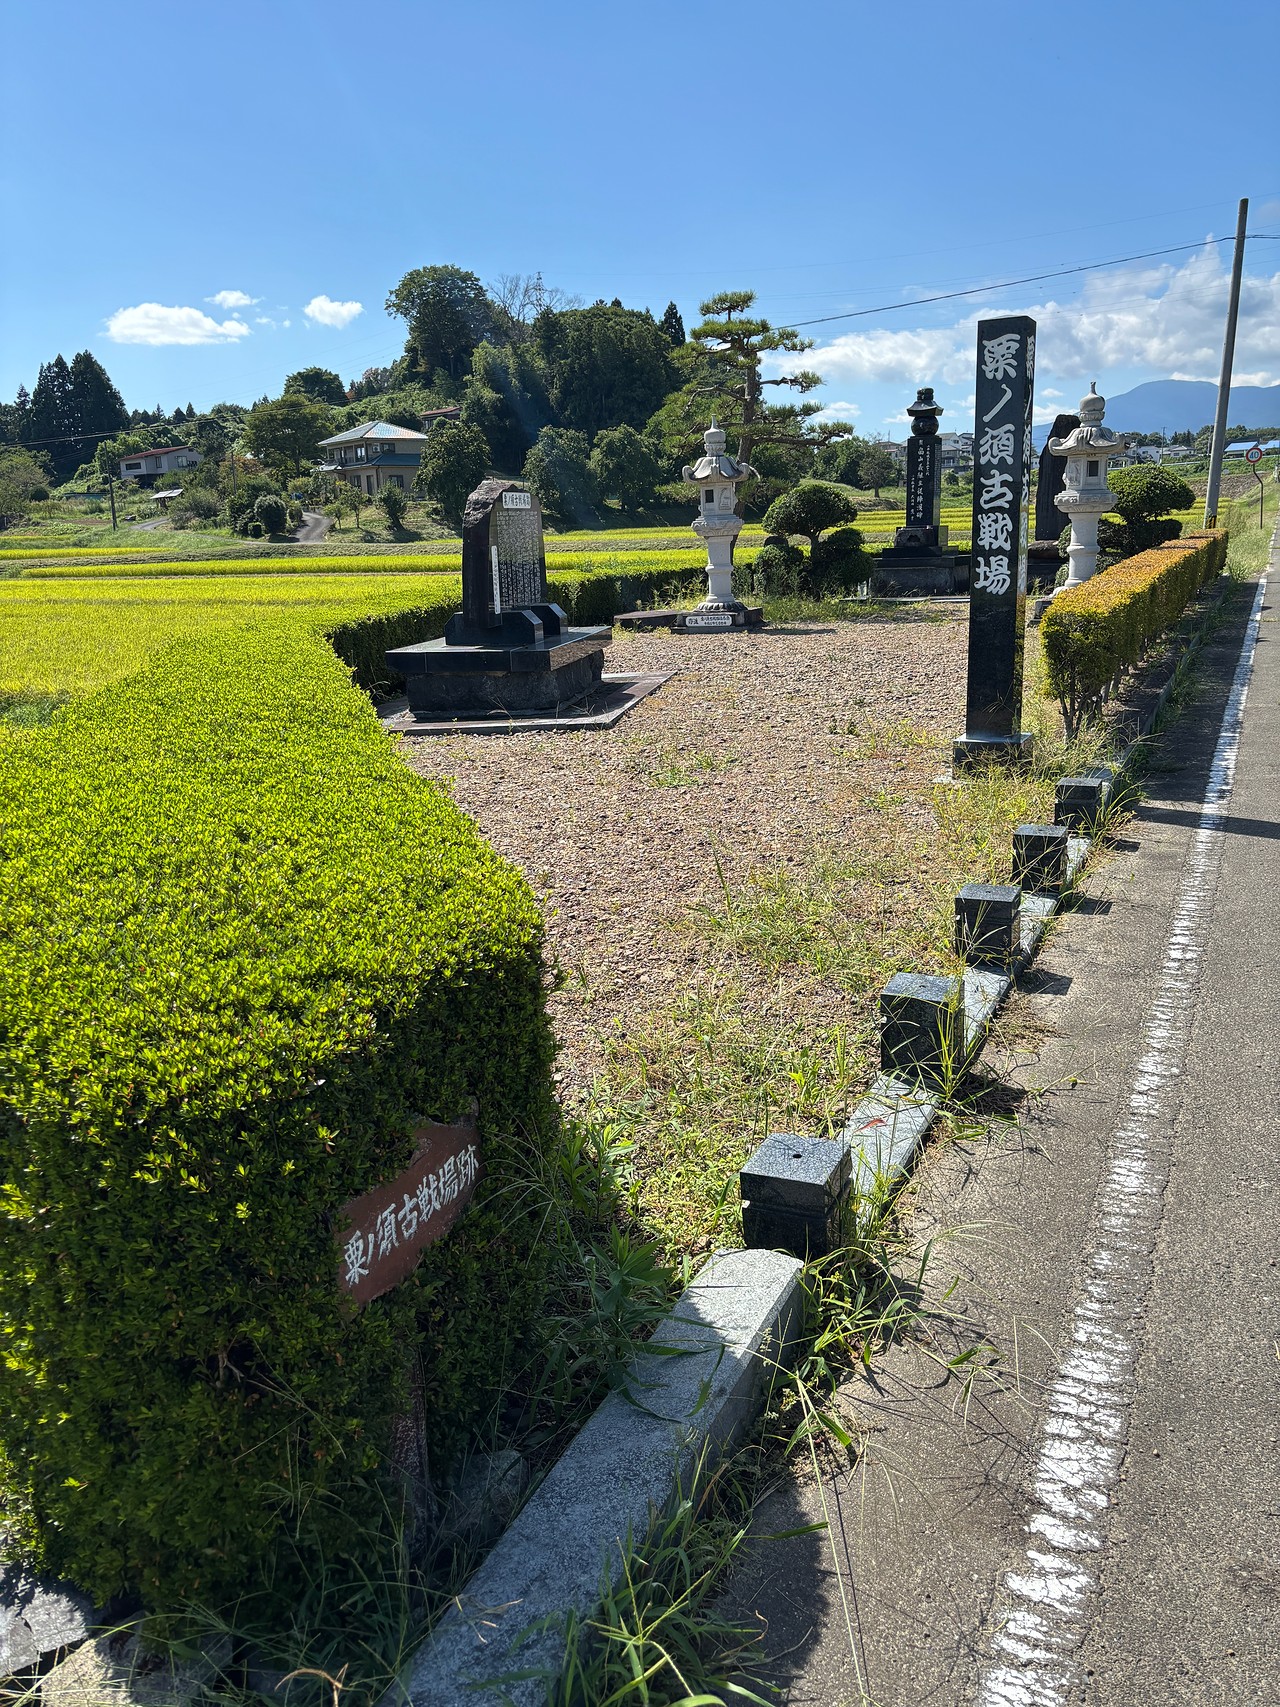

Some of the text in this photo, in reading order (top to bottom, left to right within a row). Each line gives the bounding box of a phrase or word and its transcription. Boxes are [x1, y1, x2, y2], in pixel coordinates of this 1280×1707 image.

[974, 333, 1021, 596] 粟ノ須古戦場
[1250, 451, 1260, 459] 40
[344, 1144, 479, 1287] 粟ノ須古戦場跡
